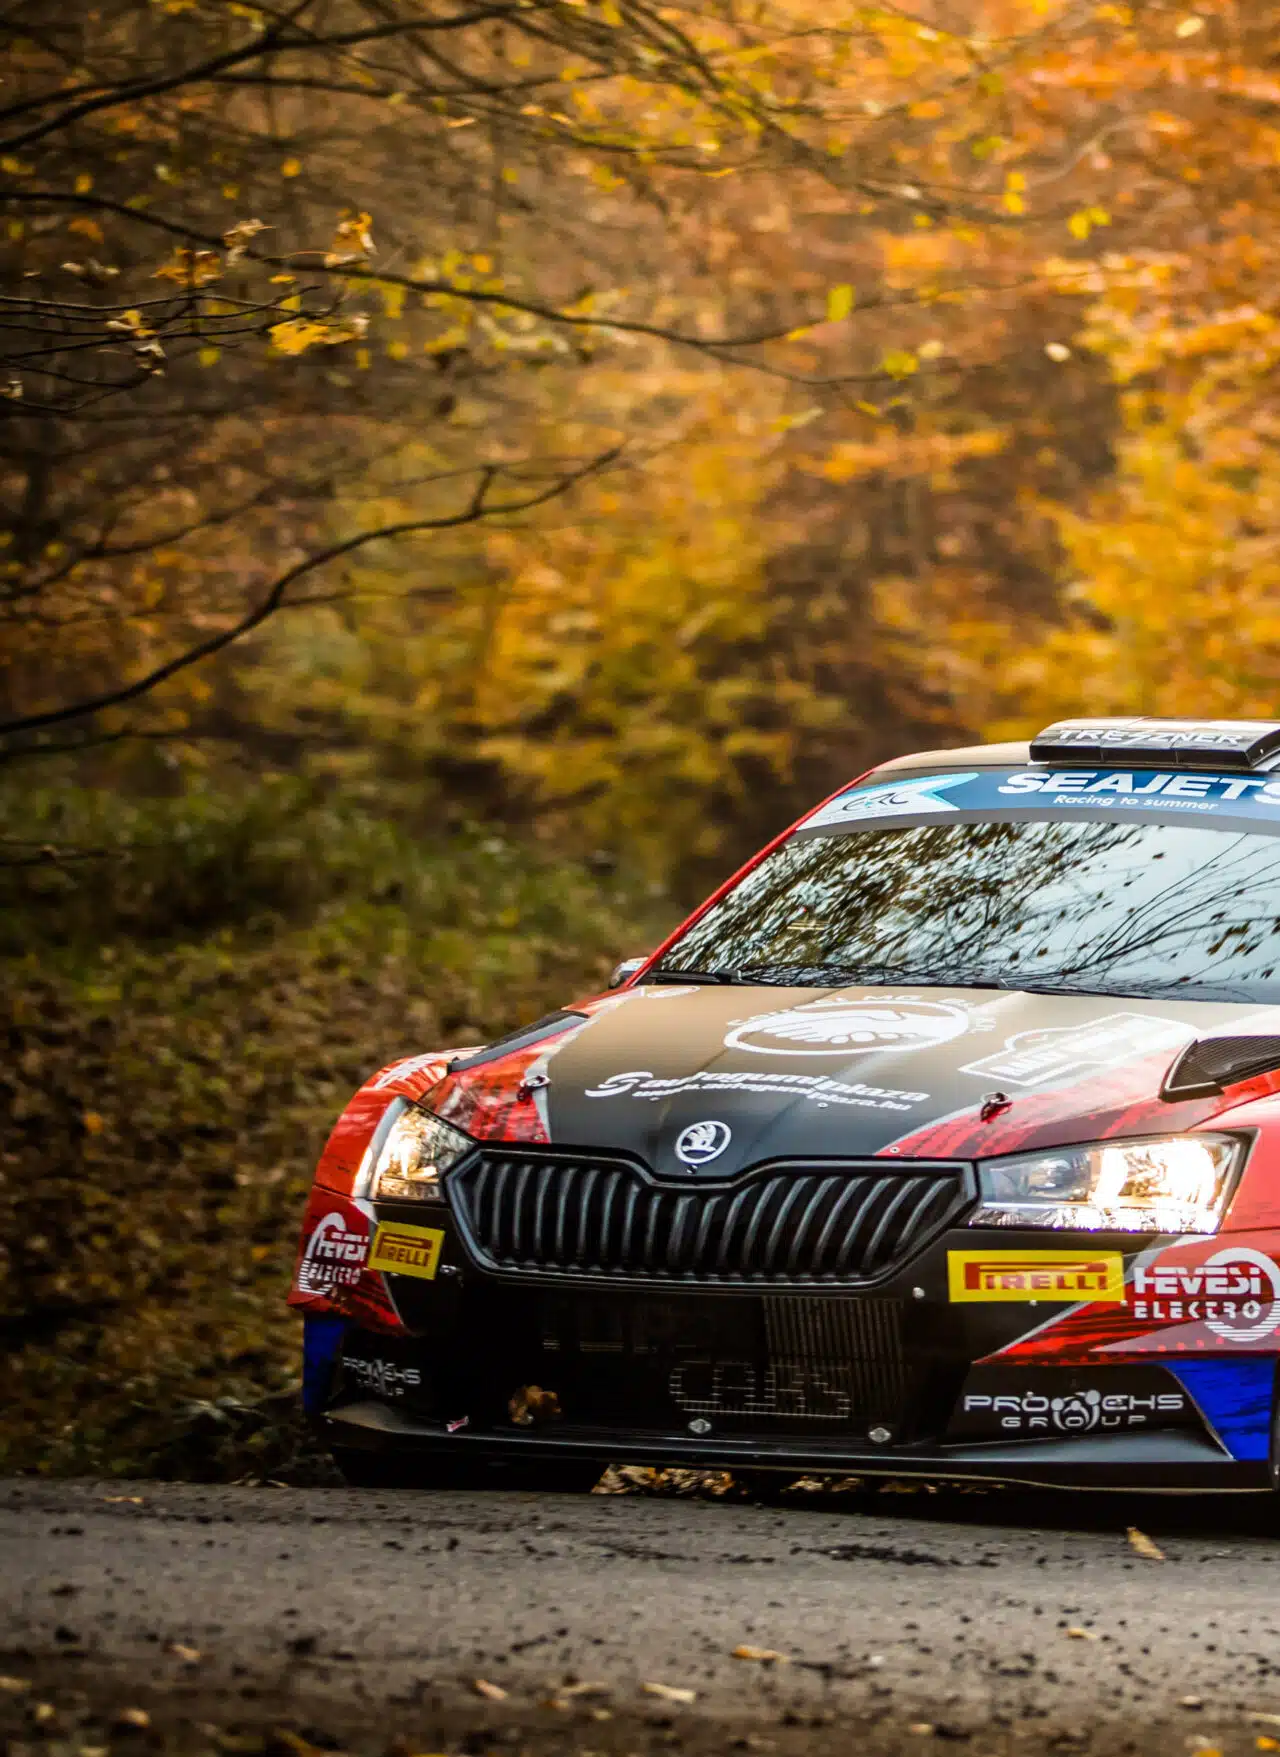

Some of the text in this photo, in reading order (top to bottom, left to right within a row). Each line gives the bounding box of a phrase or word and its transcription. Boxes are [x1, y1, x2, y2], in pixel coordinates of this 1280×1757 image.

[1053, 794, 1219, 811] Racing to summer
[375, 1231, 433, 1267] PIRELLI
[963, 1262, 1108, 1290] PIRELLI
[1001, 1415, 1147, 1428] GROUP
